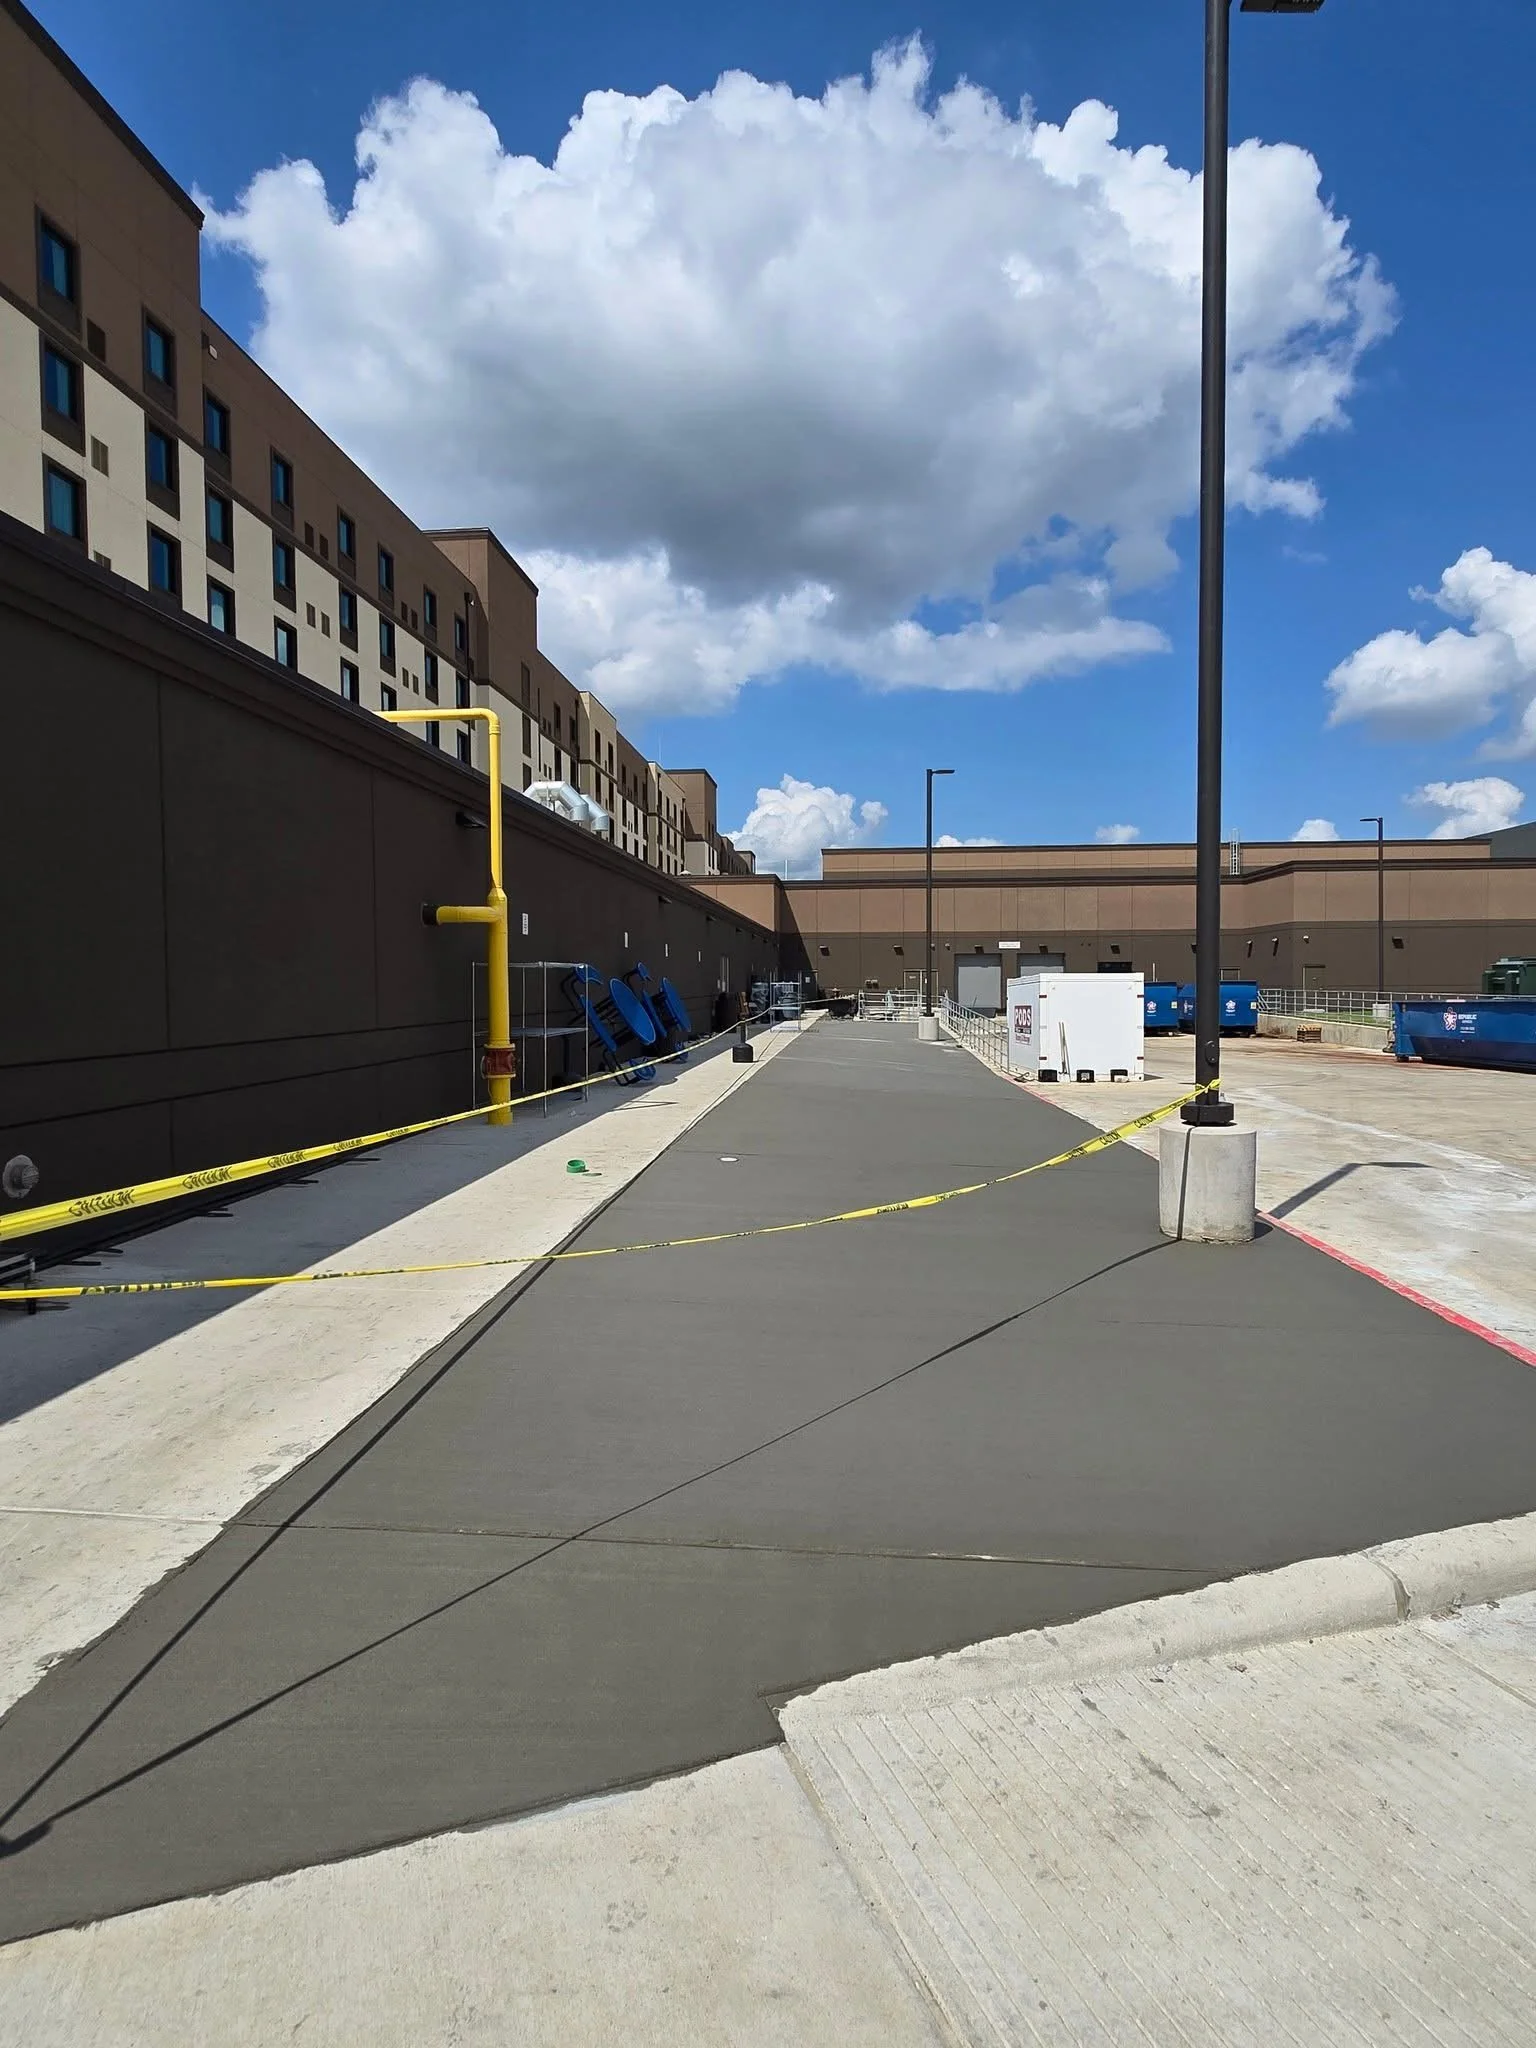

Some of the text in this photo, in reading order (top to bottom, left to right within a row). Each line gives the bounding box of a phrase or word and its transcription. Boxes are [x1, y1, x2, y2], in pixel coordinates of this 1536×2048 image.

[1015, 1008, 1031, 1026] PODS
[1134, 1113, 1157, 1129] CAUTION
[1100, 1130, 1122, 1146] CAUTION
